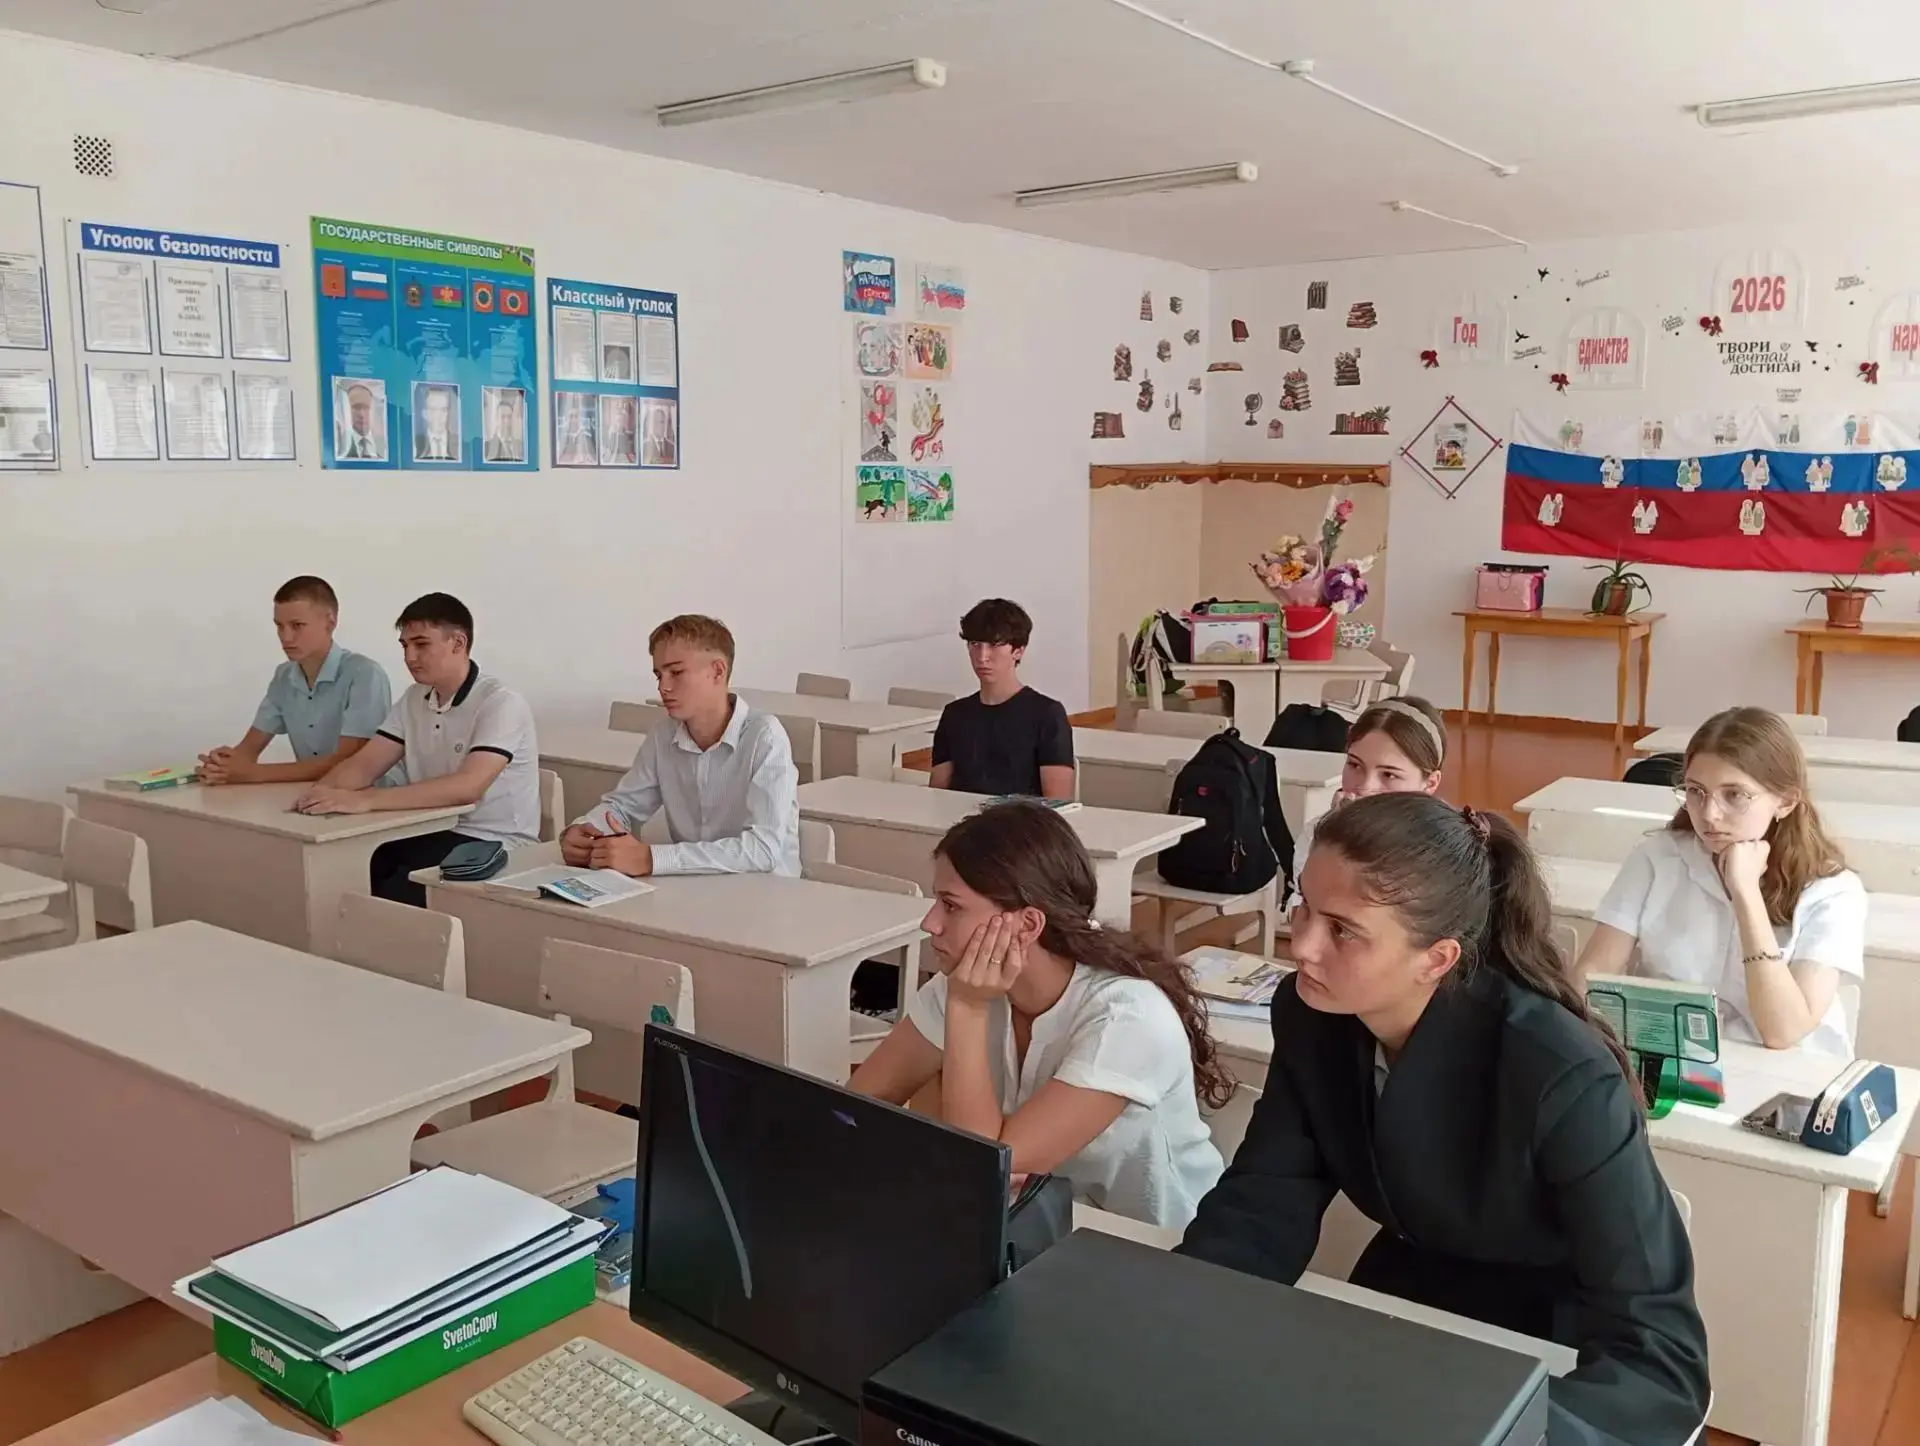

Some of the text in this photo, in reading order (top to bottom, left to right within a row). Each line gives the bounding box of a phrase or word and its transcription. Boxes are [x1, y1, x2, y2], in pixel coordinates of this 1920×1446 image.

[90, 228, 273, 263] Уголок безопасности
[320, 223, 503, 259] ГОСУДАРСТВЕННЫЕ СИМВОЛЫ
[552, 285, 673, 315] Классный уголок
[1730, 275, 1786, 313] 2026
[1453, 316, 1478, 348] Год
[1717, 341, 1770, 354] ТВОРИ
[1892, 324, 1920, 360] нар
[1578, 337, 1629, 372] единства
[1730, 360, 1801, 376] ДОСТИГАЙ
[442, 1311, 498, 1350] SvetoCopy
[251, 1337, 285, 1378] SvetoCopy
[787, 1380, 800, 1396] LG
